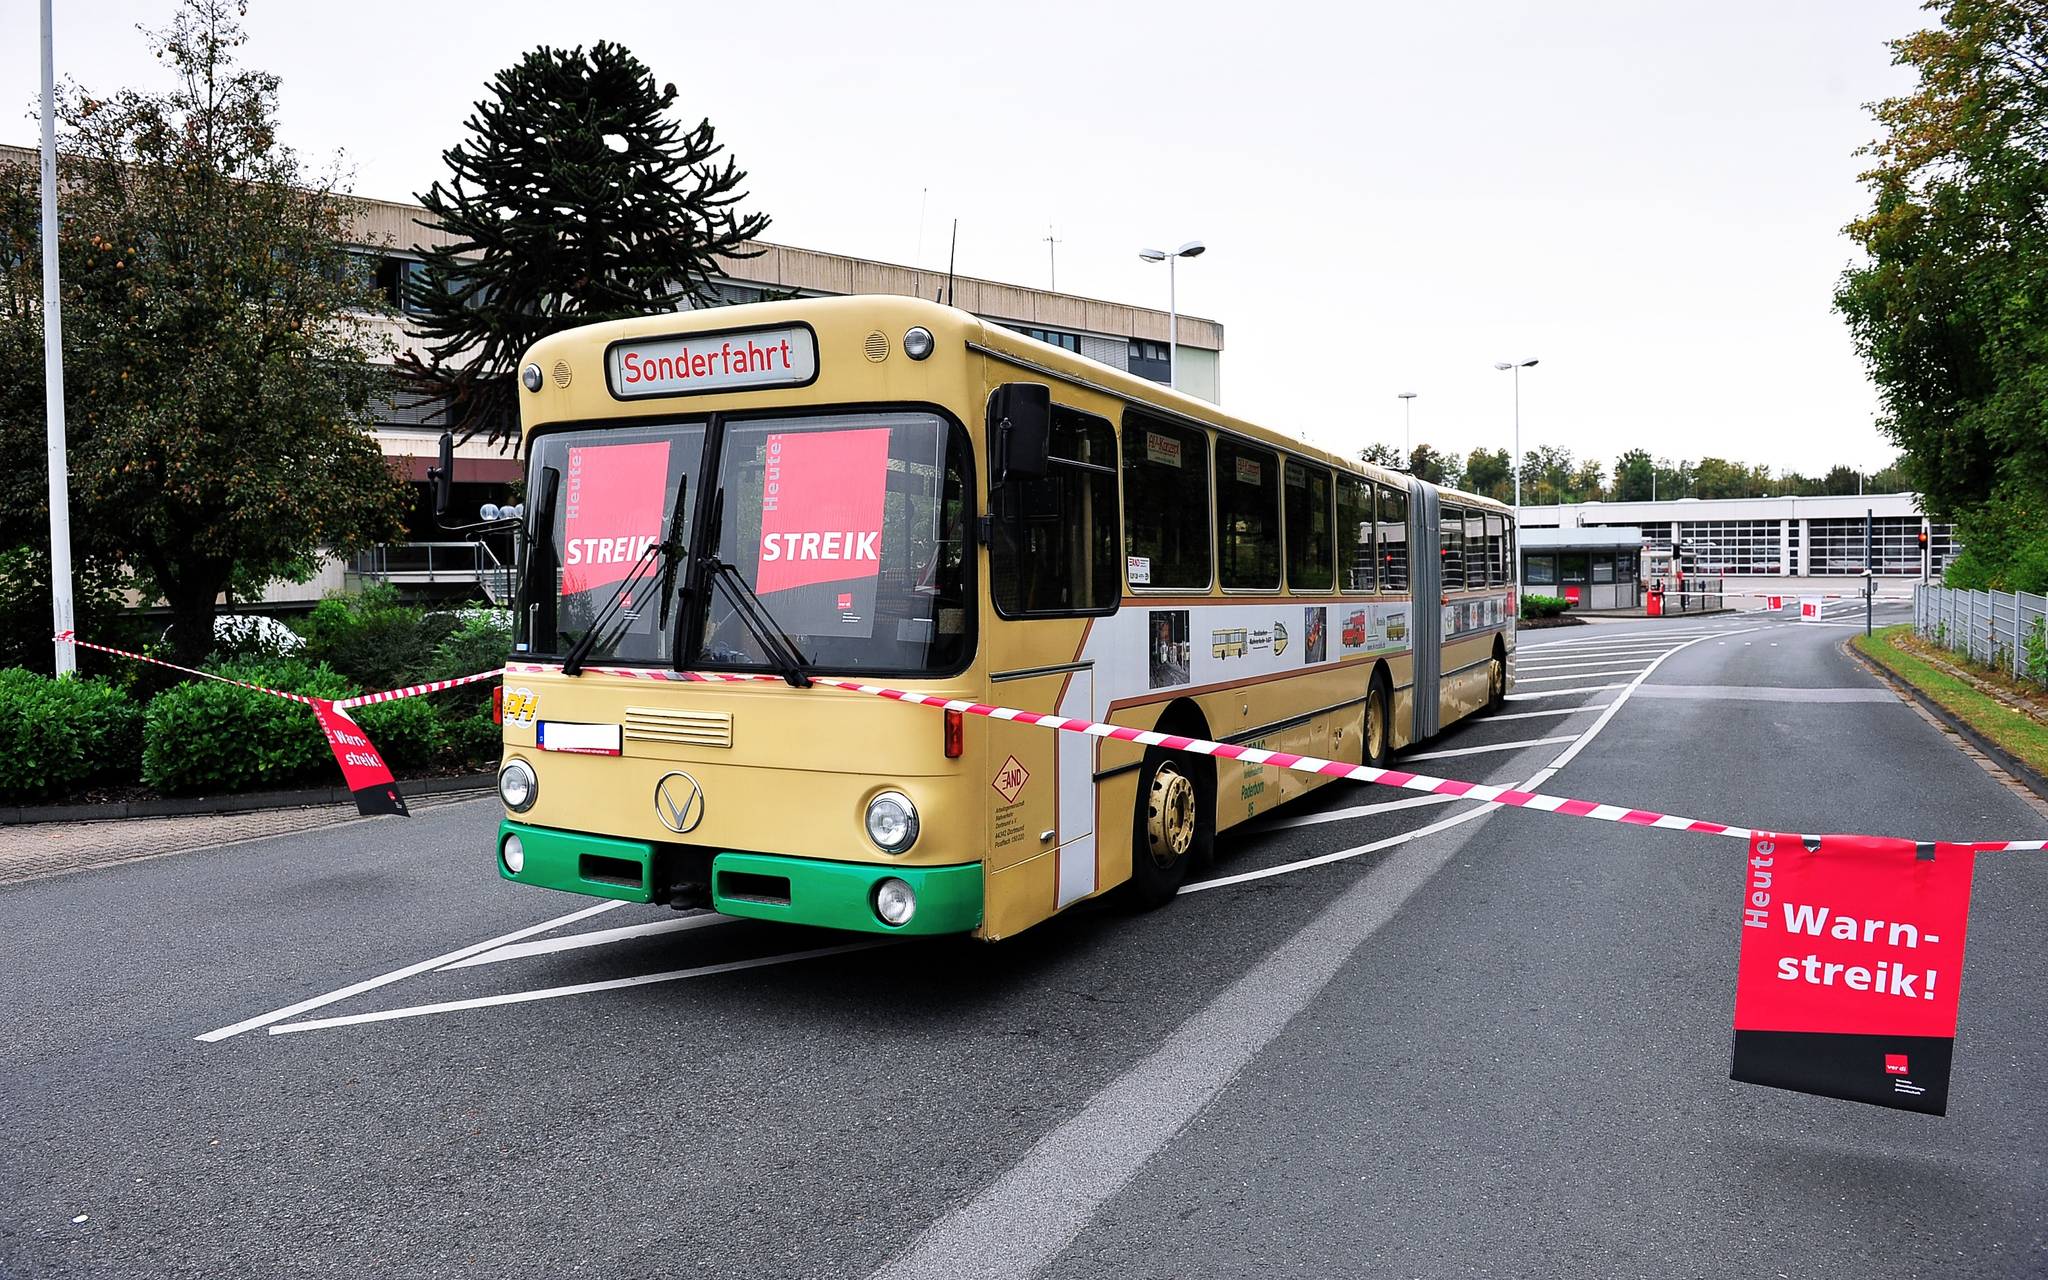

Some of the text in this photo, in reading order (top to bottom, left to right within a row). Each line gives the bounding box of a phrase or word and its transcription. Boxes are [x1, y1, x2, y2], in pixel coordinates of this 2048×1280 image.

[624, 339, 791, 384] Sonderfahrt
[567, 535, 657, 565] STREIK
[763, 531, 879, 562] STREIK
[345, 751, 382, 767] streik!
[1744, 831, 1776, 929] Heute:
[1783, 903, 1940, 949] Warn-
[1777, 954, 1938, 1001] streik!
